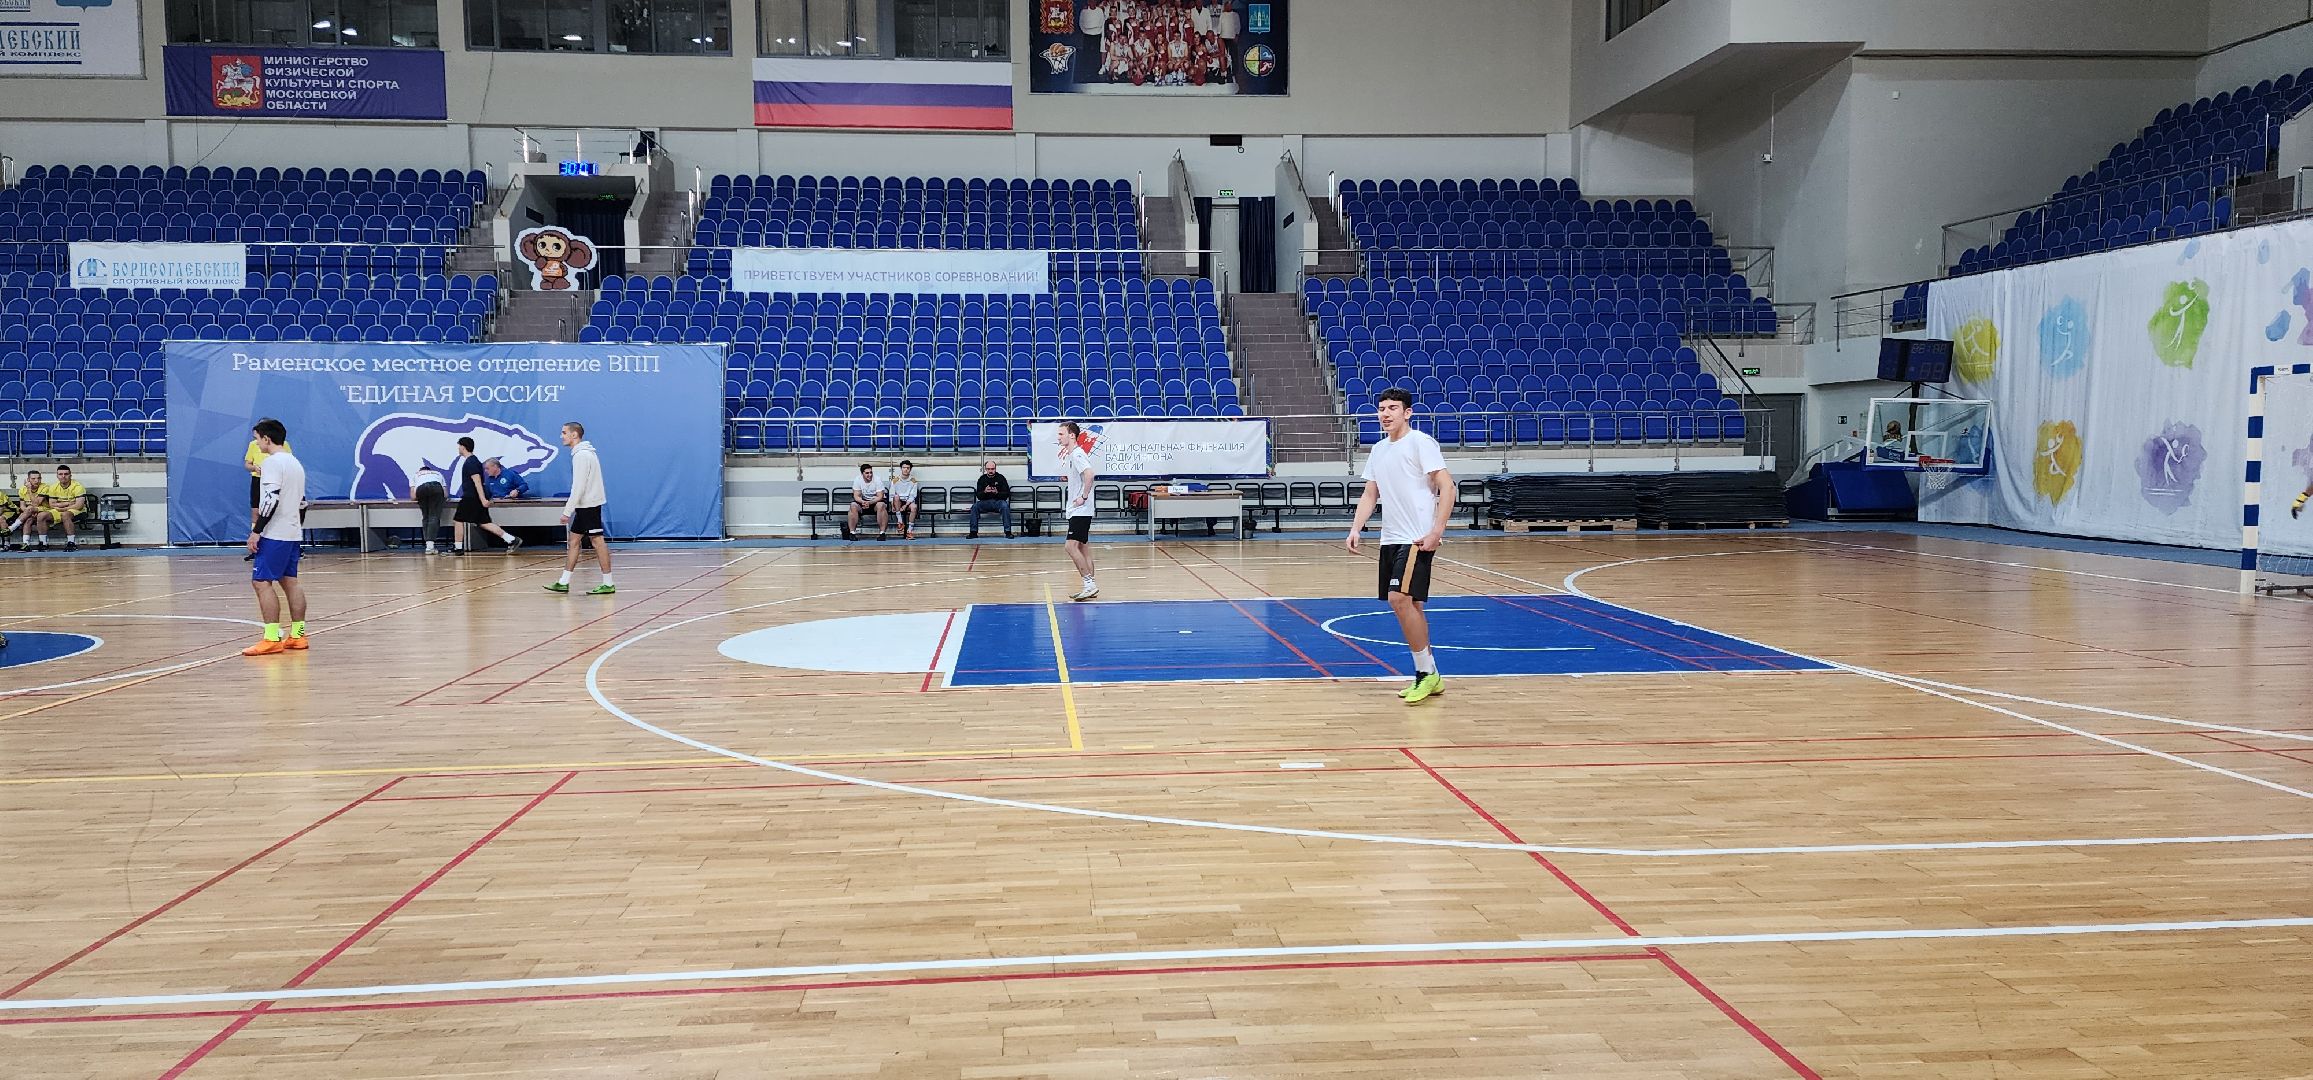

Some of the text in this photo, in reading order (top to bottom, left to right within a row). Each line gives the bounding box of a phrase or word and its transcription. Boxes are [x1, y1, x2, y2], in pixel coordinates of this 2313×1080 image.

[264, 56, 369, 66] МИНИСТЕРСТВО
[265, 67, 355, 77] ФИЗИЧЕСКОЙ
[265, 78, 400, 90] КУЛЬТУРЫ И СПОРТА
[265, 89, 357, 100] МОСКОВСКОЙ
[266, 100, 327, 110] ОБЛАСТИ
[112, 262, 240, 277] БОРИСОГЛЕБСКИЙ
[743, 270, 1039, 282] ПРИВЕТСТВУЕМ УЧАСТНИКОВ СОРЕВНОВАНИЙ!
[112, 278, 183, 286] спортивный
[232, 353, 660, 373] Раменское местное отделение ВПП
[339, 385, 565, 405] "ЕДИНАЯ РОССИЯ"
[1105, 443, 1185, 451] НАЦИОНАЛЬНАЯ
[1105, 453, 1174, 462] БАДМИНТОНА
[1105, 463, 1144, 471] РОССИИ
